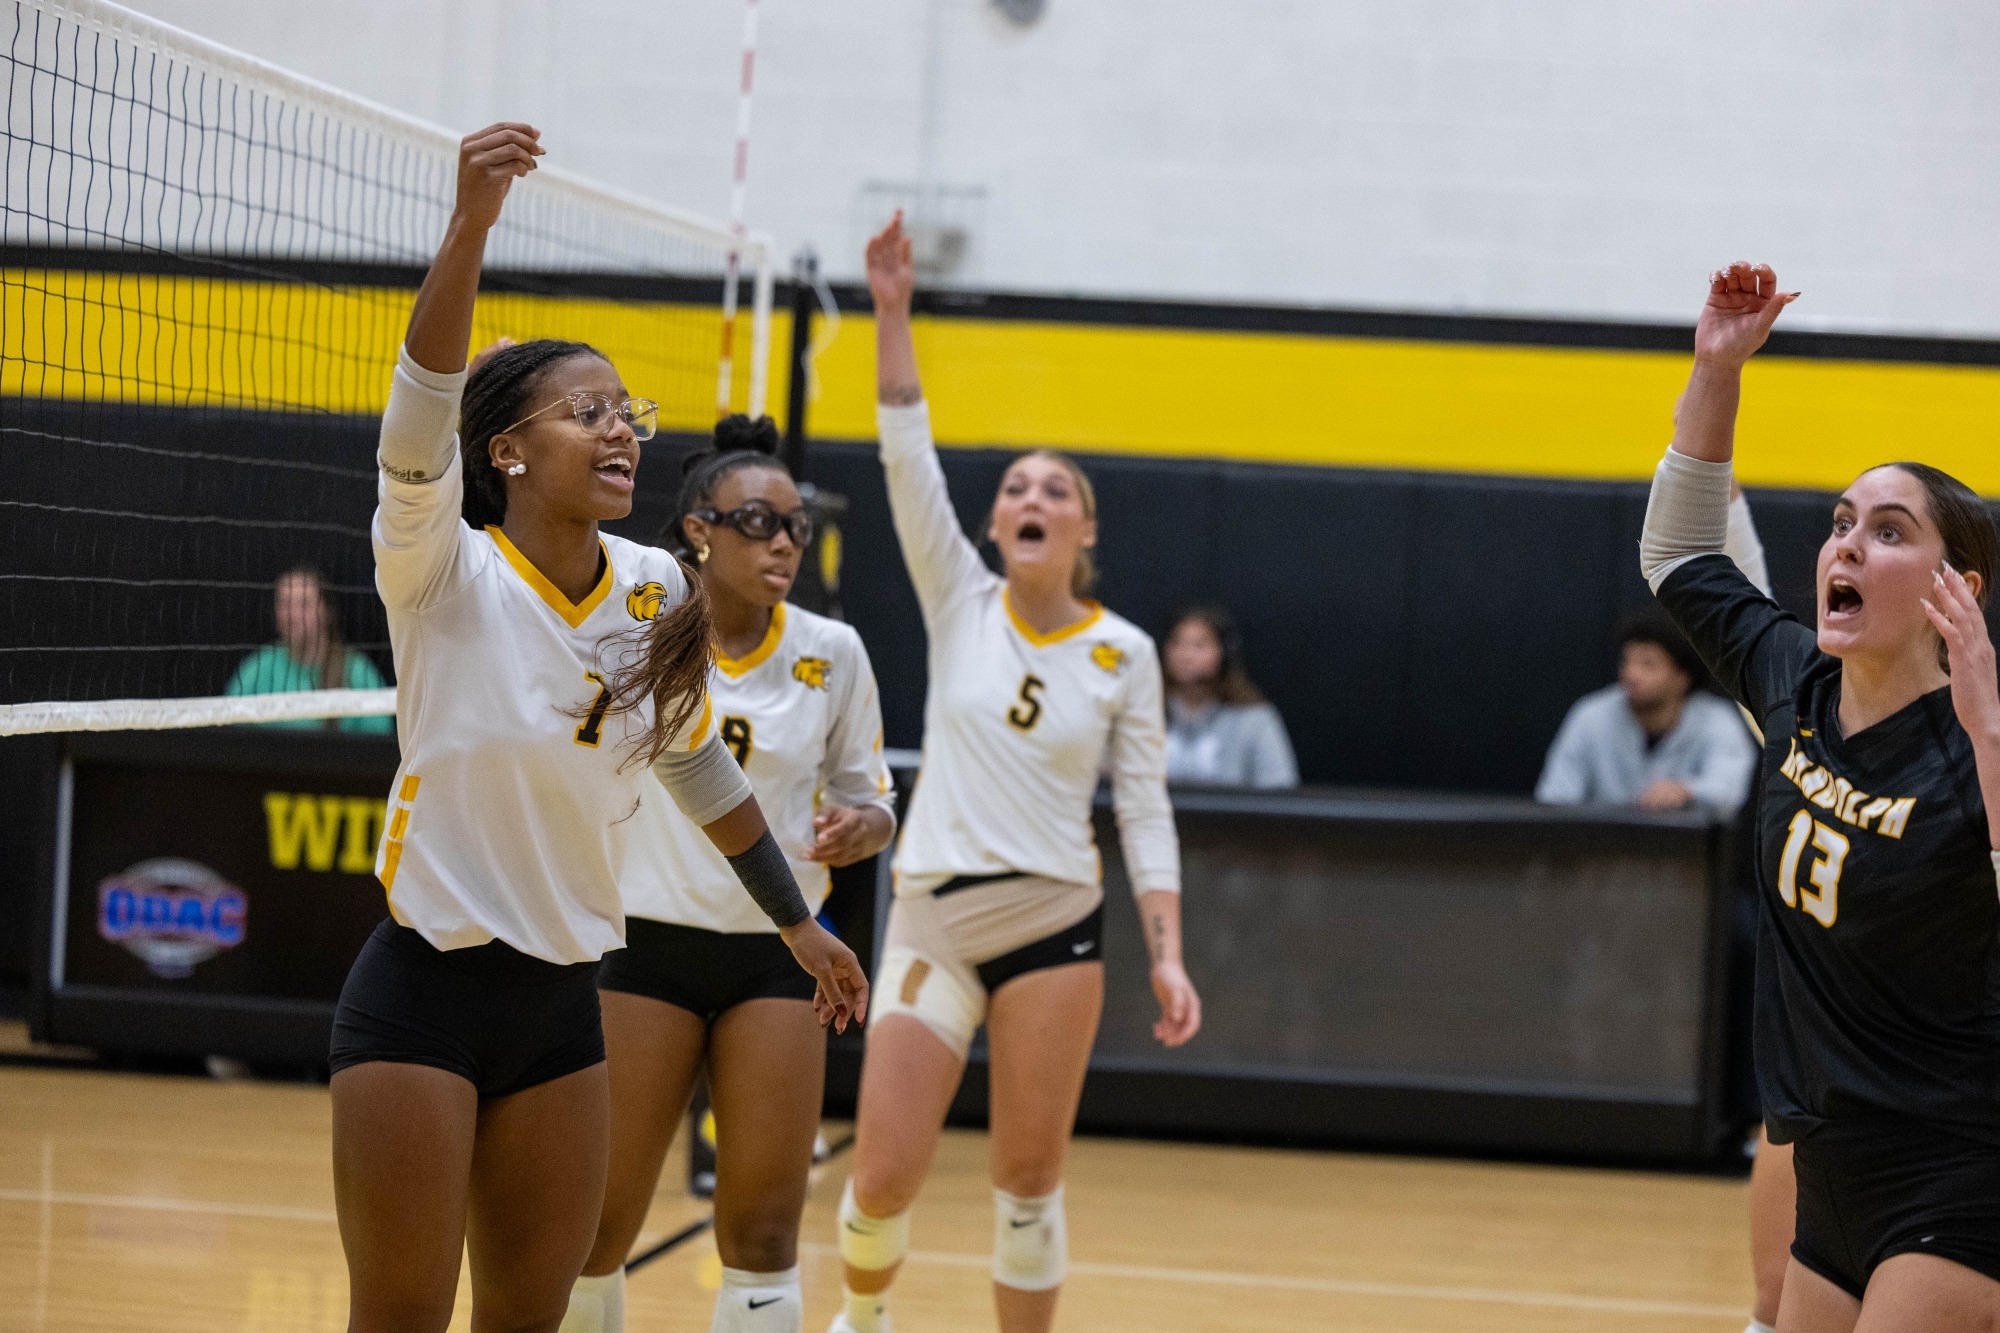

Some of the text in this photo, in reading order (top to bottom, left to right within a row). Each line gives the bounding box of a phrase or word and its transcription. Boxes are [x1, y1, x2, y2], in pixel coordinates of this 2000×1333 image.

[1006, 672, 1046, 733] 5
[1778, 808, 1850, 928] 13
[104, 884, 246, 945] ODAC
